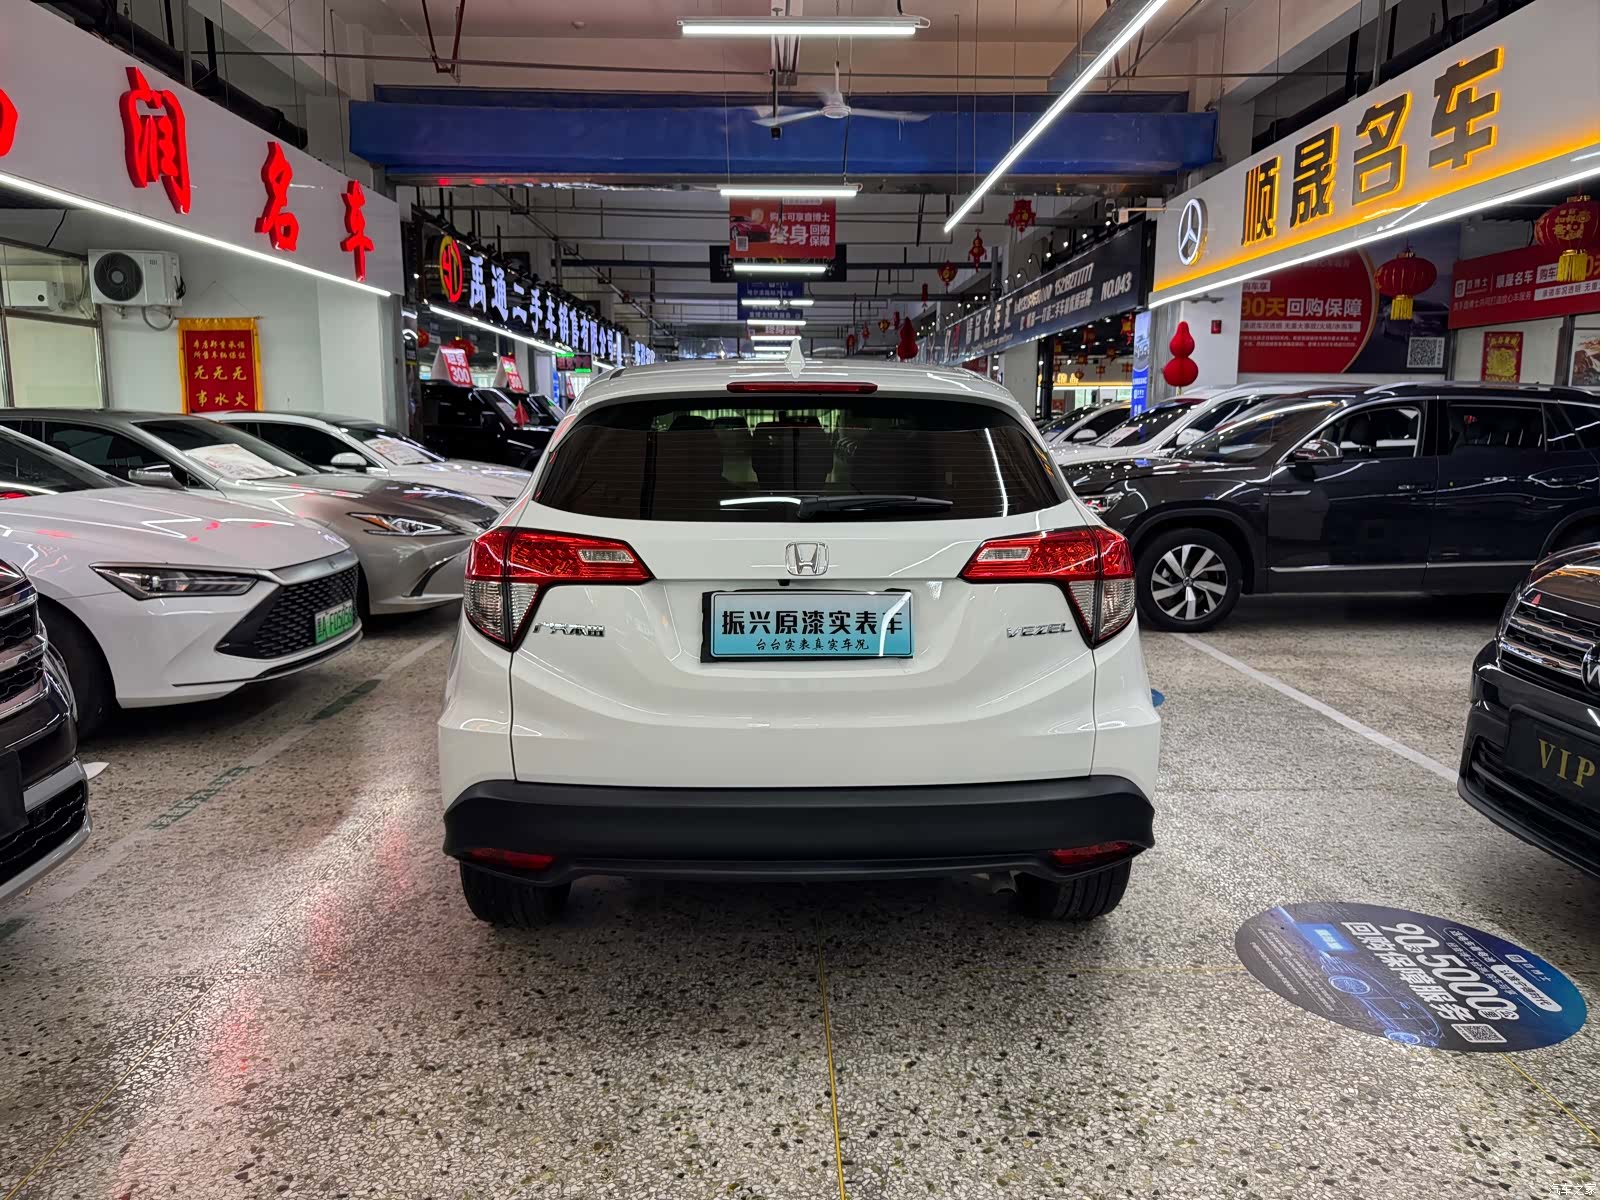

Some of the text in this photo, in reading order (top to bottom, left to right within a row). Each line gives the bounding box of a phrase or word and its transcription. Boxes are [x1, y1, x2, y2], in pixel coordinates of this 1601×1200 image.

[1241, 46, 1504, 247] 顺晟名车
[0, 66, 374, 281] 润名车
[1100, 271, 1133, 302] NO.043
[451, 368, 470, 383] 300
[722, 609, 904, 635] 振兴原漆实表车
[1007, 622, 1073, 638] VEZEL
[756, 637, 869, 651] 台台实表真实车况
[1538, 738, 1596, 788] VIP
[1340, 921, 1476, 1023] 回购保障服务
